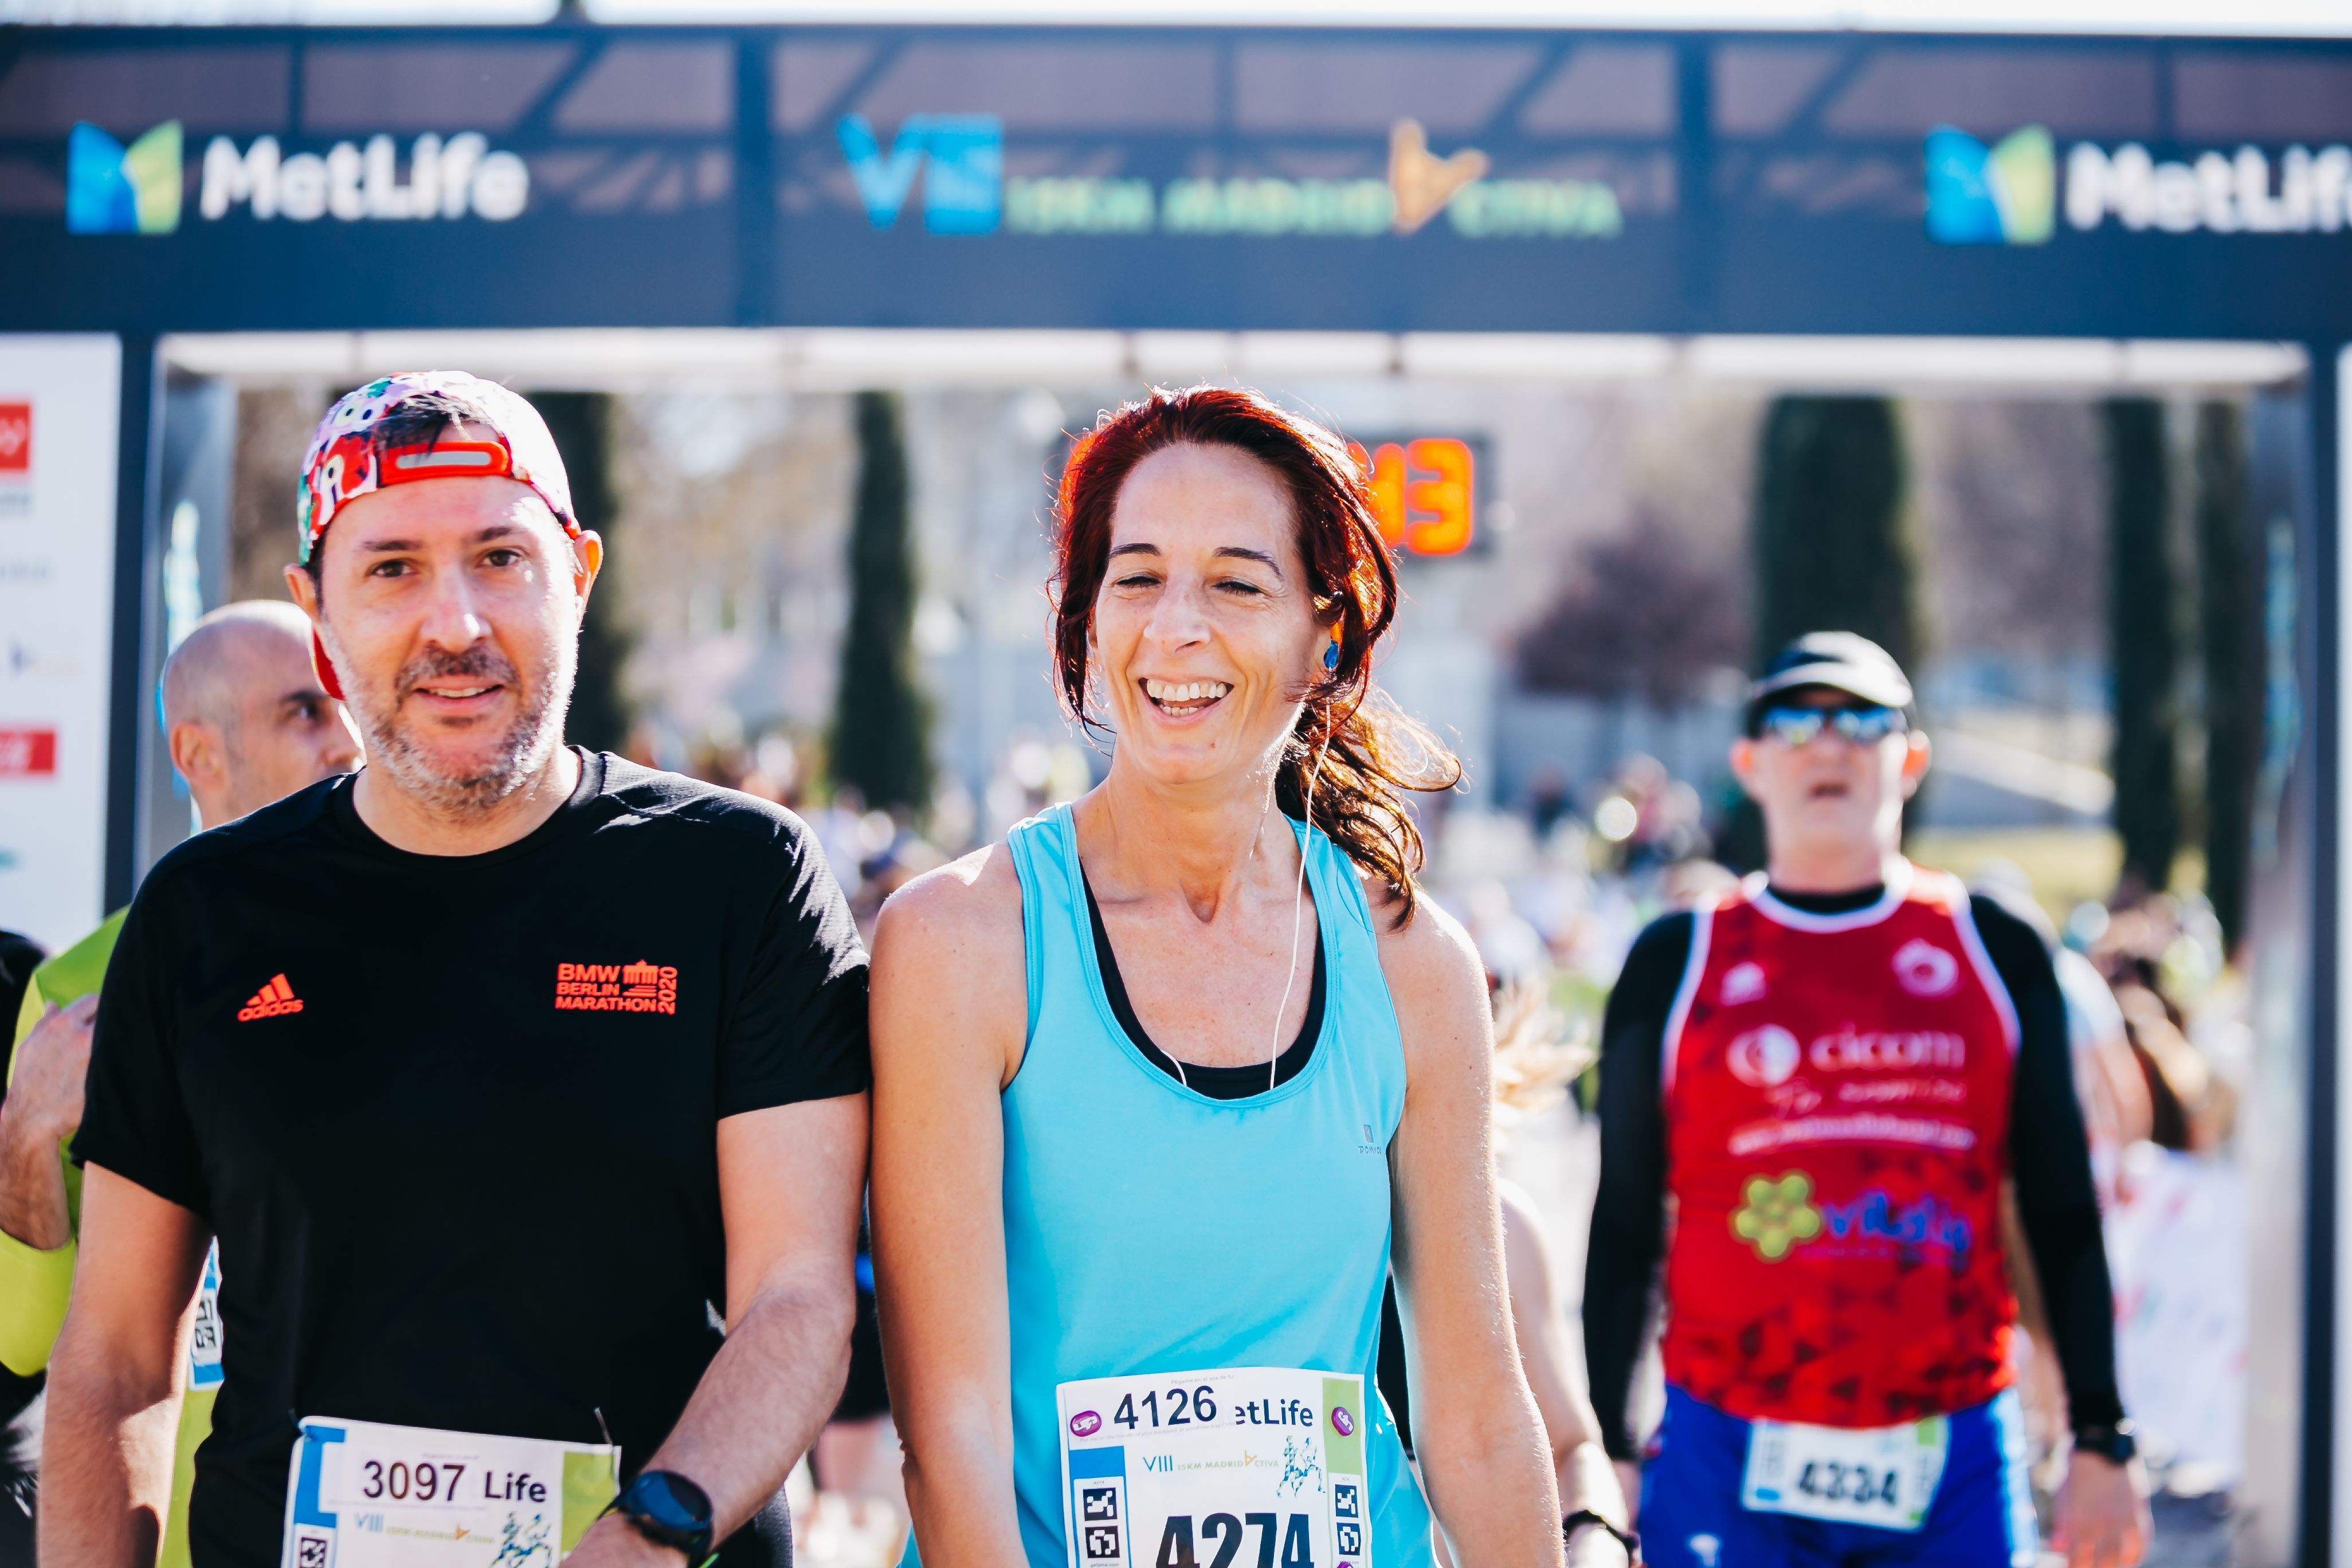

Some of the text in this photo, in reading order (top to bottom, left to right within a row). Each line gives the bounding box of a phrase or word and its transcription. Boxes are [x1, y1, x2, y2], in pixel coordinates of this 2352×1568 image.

[201, 132, 529, 221] MetLife
[2067, 140, 2352, 233] MetLif
[556, 982, 620, 996] BERLIN
[558, 963, 621, 982] BMW
[658, 966, 678, 1015] 2020
[237, 999, 303, 1021] adidas
[555, 996, 657, 1012] MARATHON
[1114, 1385, 1217, 1429] 4126
[364, 1461, 546, 1503] 3097 Life
[1143, 1455, 1173, 1472] VIII
[1177, 1463, 1202, 1471] 15KM
[1205, 1460, 1244, 1468] MADRID
[1798, 1462, 1898, 1506] 4334
[1156, 1512, 1314, 1568] 4274
